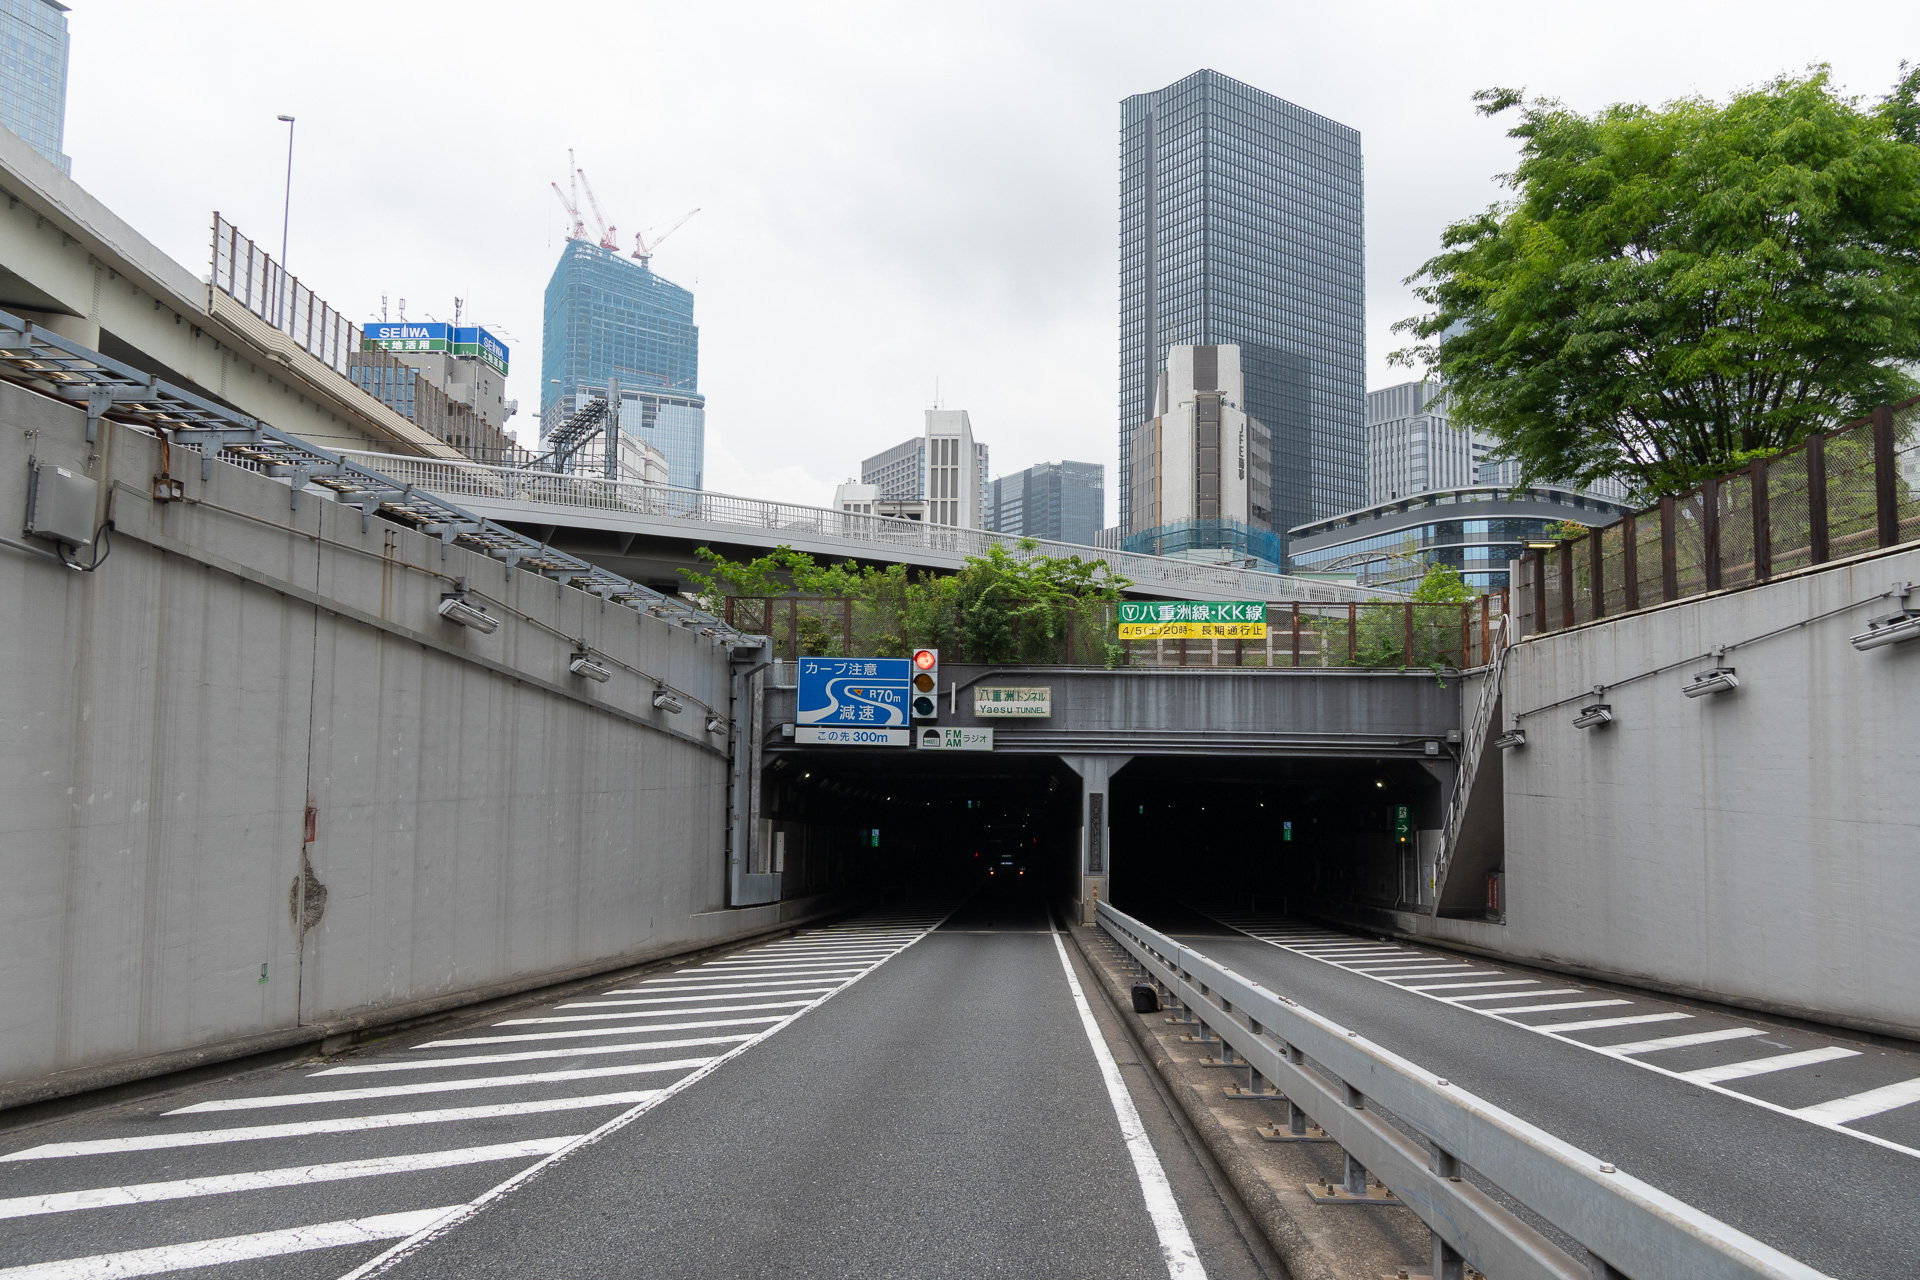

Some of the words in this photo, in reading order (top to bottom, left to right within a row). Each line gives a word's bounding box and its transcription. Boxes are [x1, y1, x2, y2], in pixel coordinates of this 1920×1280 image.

[378, 340, 430, 350] 土地活用
[1201, 625, 1263, 635] 長期通行止
[805, 662, 878, 676] カーブ注意
[869, 689, 901, 703] R70m
[980, 689, 1046, 702] 八重洲トンネル
[839, 704, 875, 721] 減速
[980, 705, 1013, 714] Yaesu
[945, 729, 962, 738] FM
[963, 734, 988, 743] ラジオ
[945, 738, 962, 747] AM
